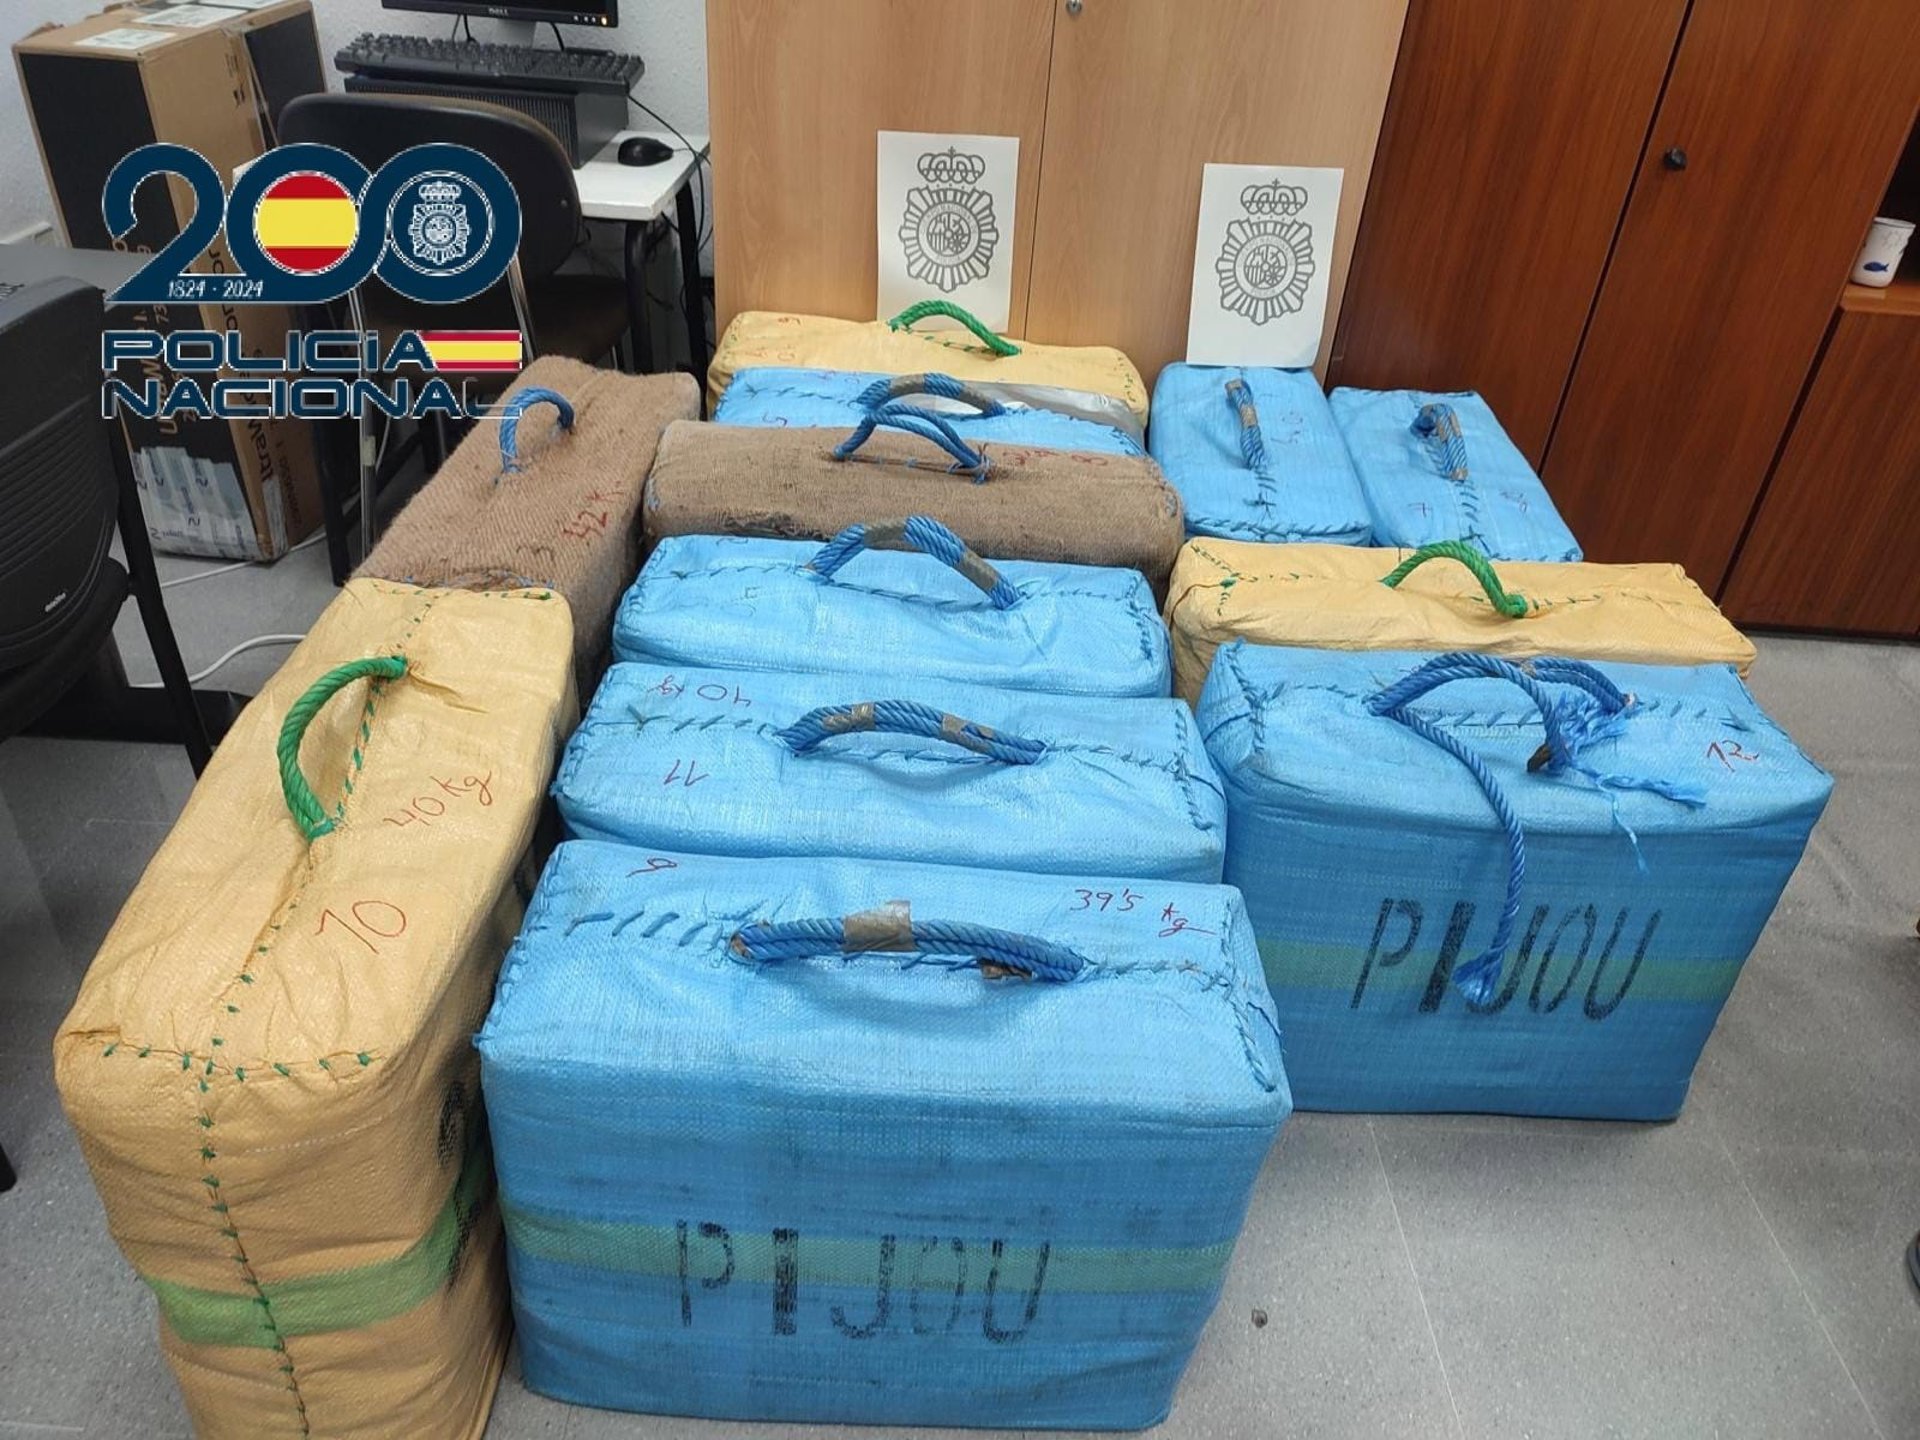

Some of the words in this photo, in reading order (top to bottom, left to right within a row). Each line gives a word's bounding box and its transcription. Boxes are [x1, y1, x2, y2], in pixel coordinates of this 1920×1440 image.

[697, 684, 752, 708] 40
[383, 796, 446, 827] 40
[314, 900, 407, 955] 10
